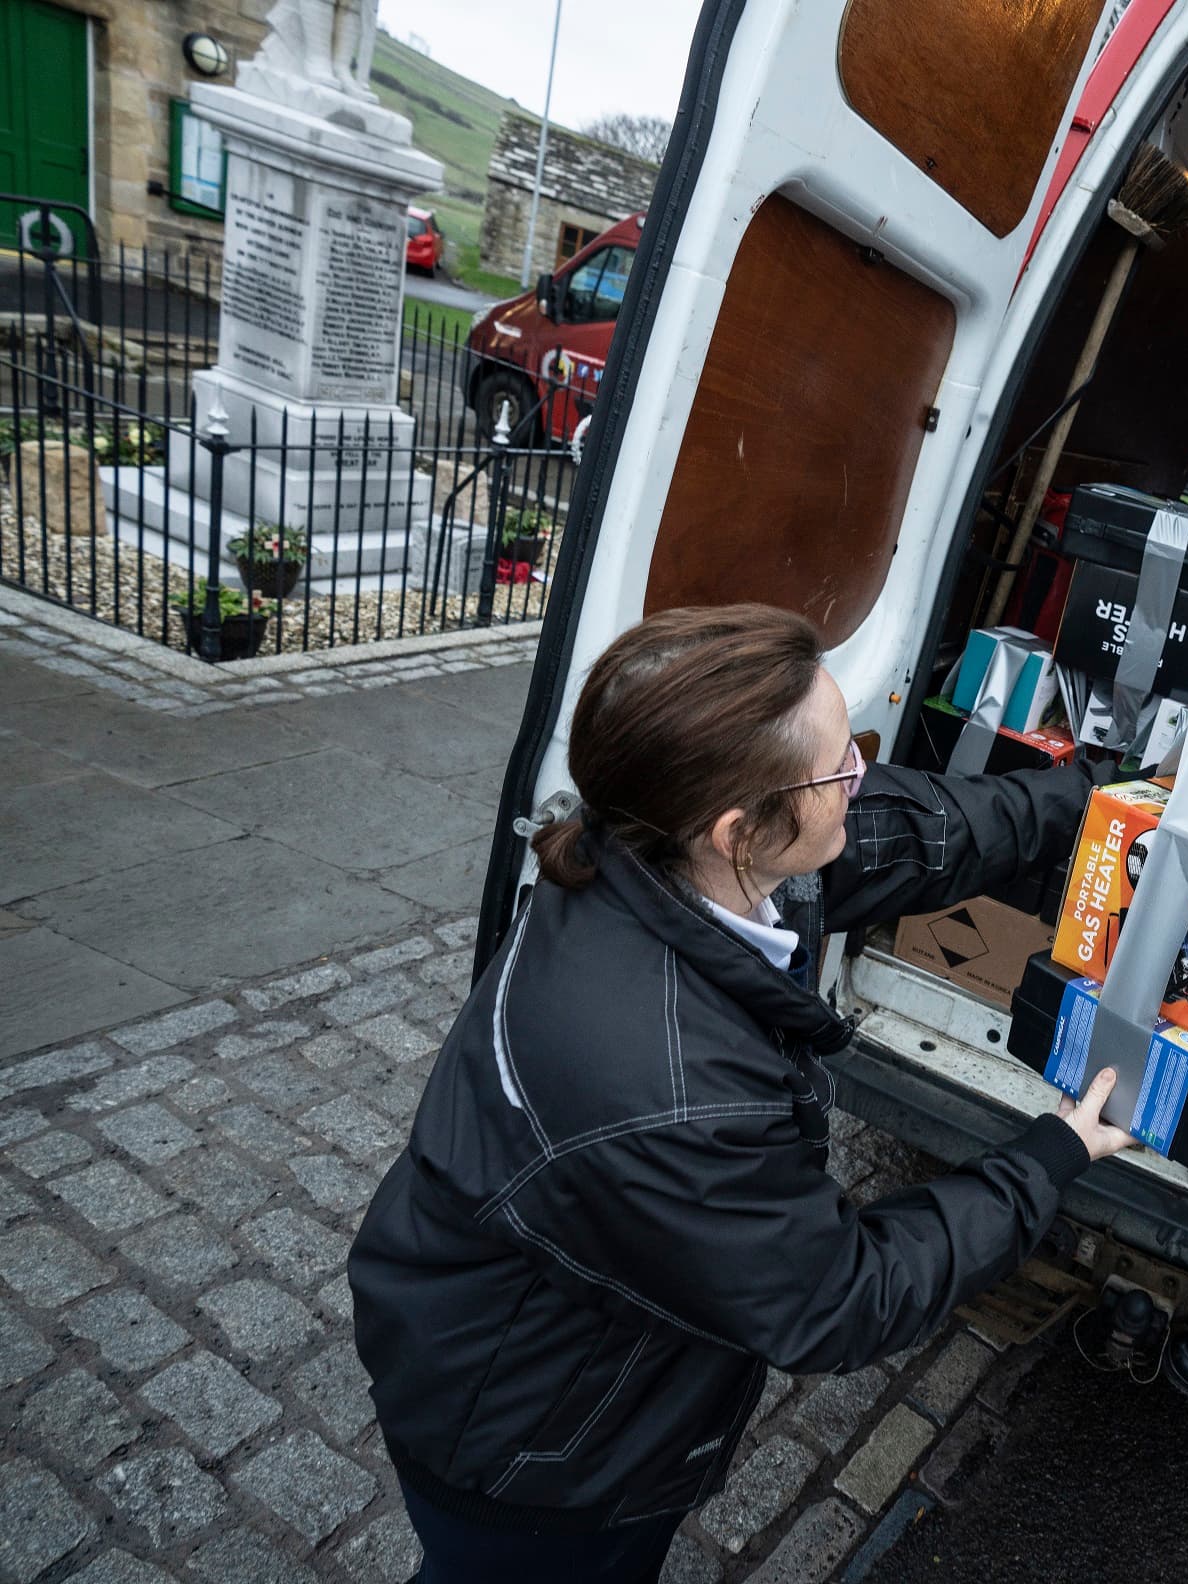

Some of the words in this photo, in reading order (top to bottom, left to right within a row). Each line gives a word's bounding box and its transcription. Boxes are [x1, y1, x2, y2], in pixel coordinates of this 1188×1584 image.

[1074, 841, 1101, 921] PORTABLE
[1078, 914, 1101, 962] GAS
[1090, 818, 1127, 912] HEATER
